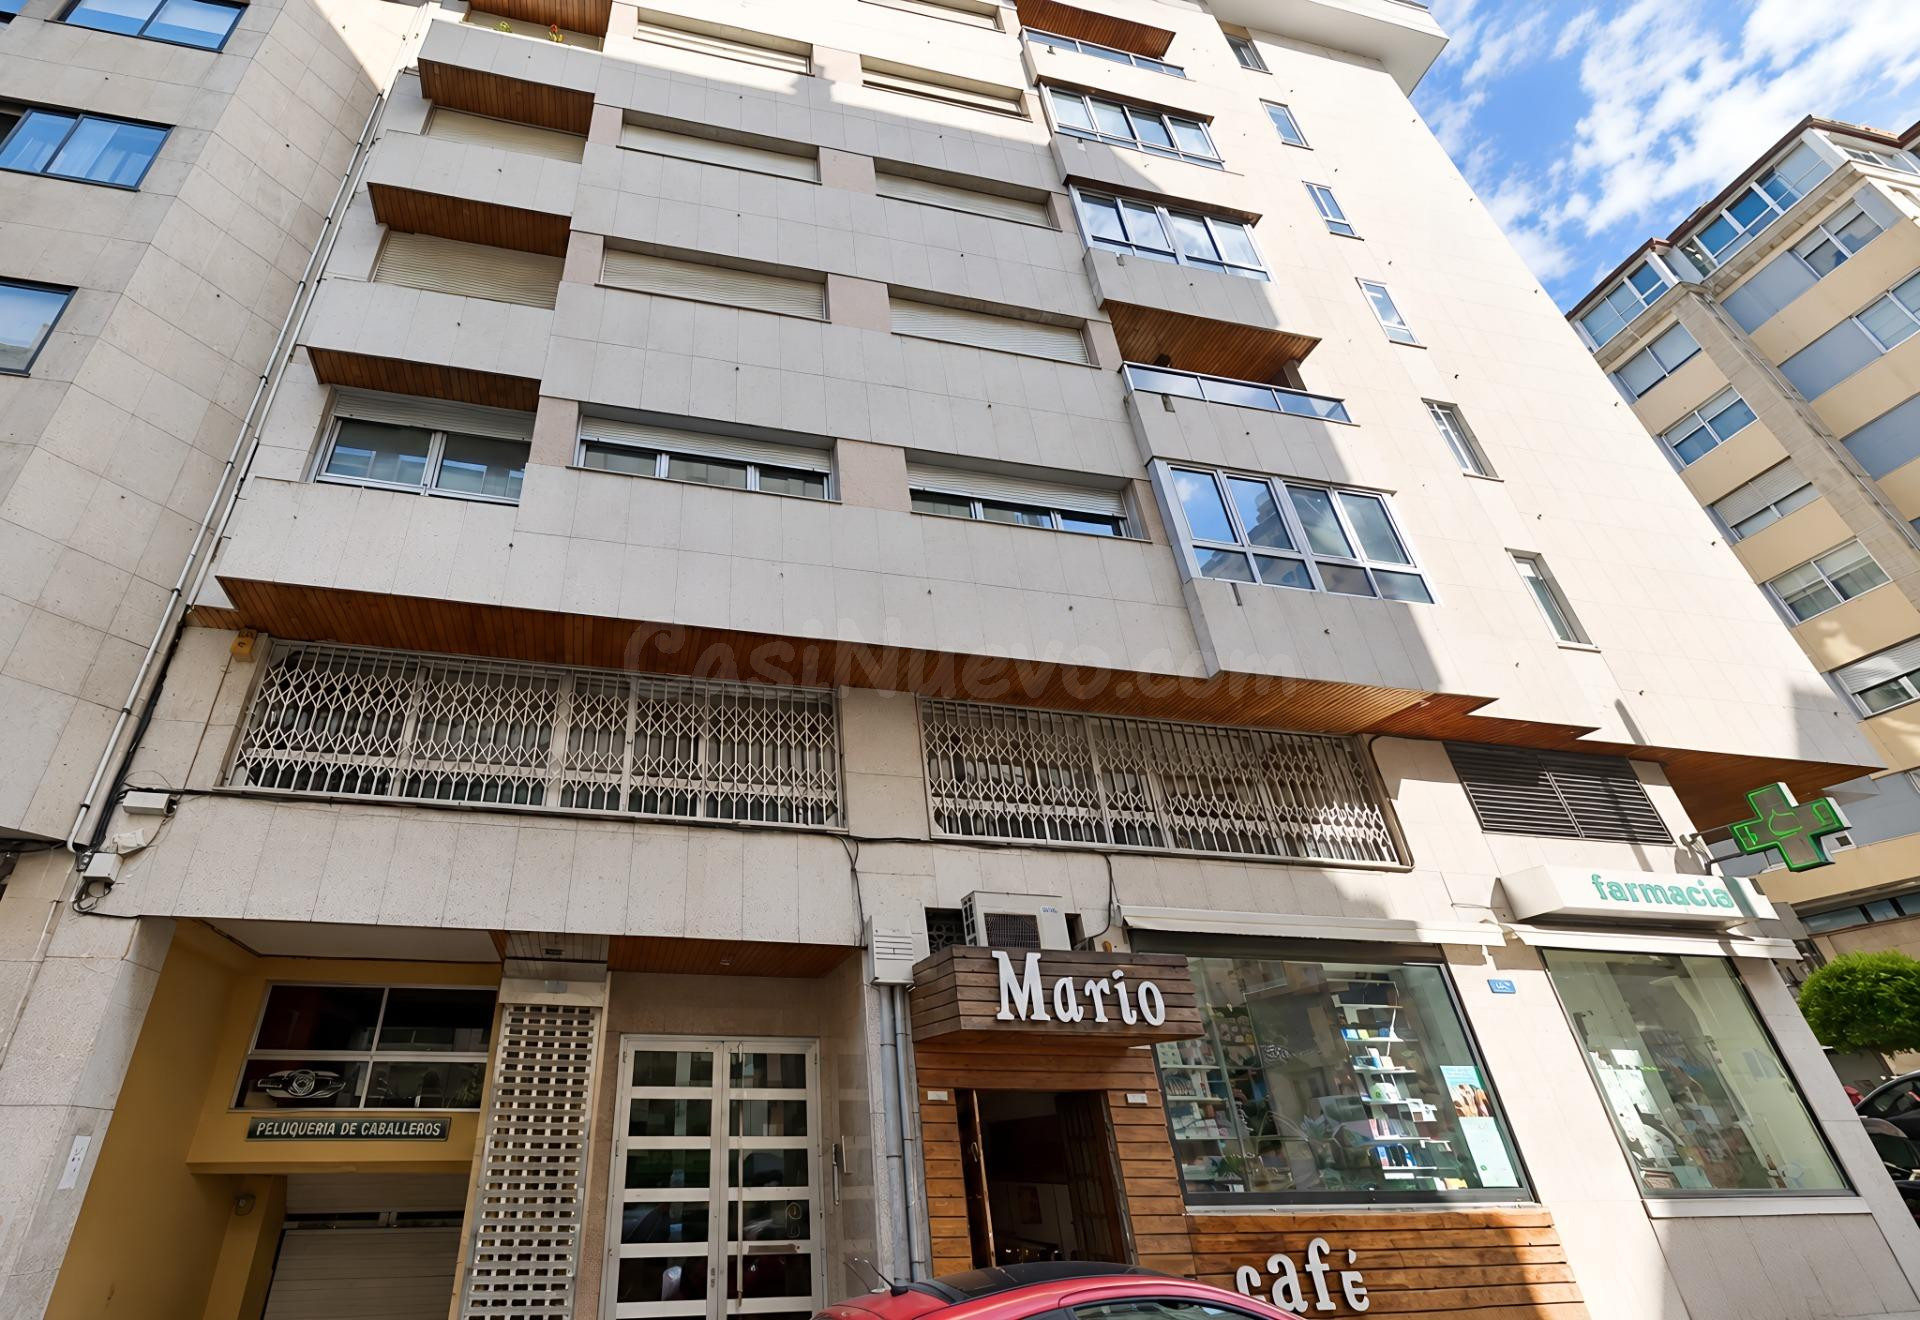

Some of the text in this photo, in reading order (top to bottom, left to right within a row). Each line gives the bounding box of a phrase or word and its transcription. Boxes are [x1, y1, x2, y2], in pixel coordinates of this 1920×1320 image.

[1591, 873, 1735, 909] farmacia
[991, 950, 1166, 1027] Mario
[256, 1121, 441, 1138] PELUQUERIA DE CABALLEROS
[1236, 1237, 1370, 1313] café
